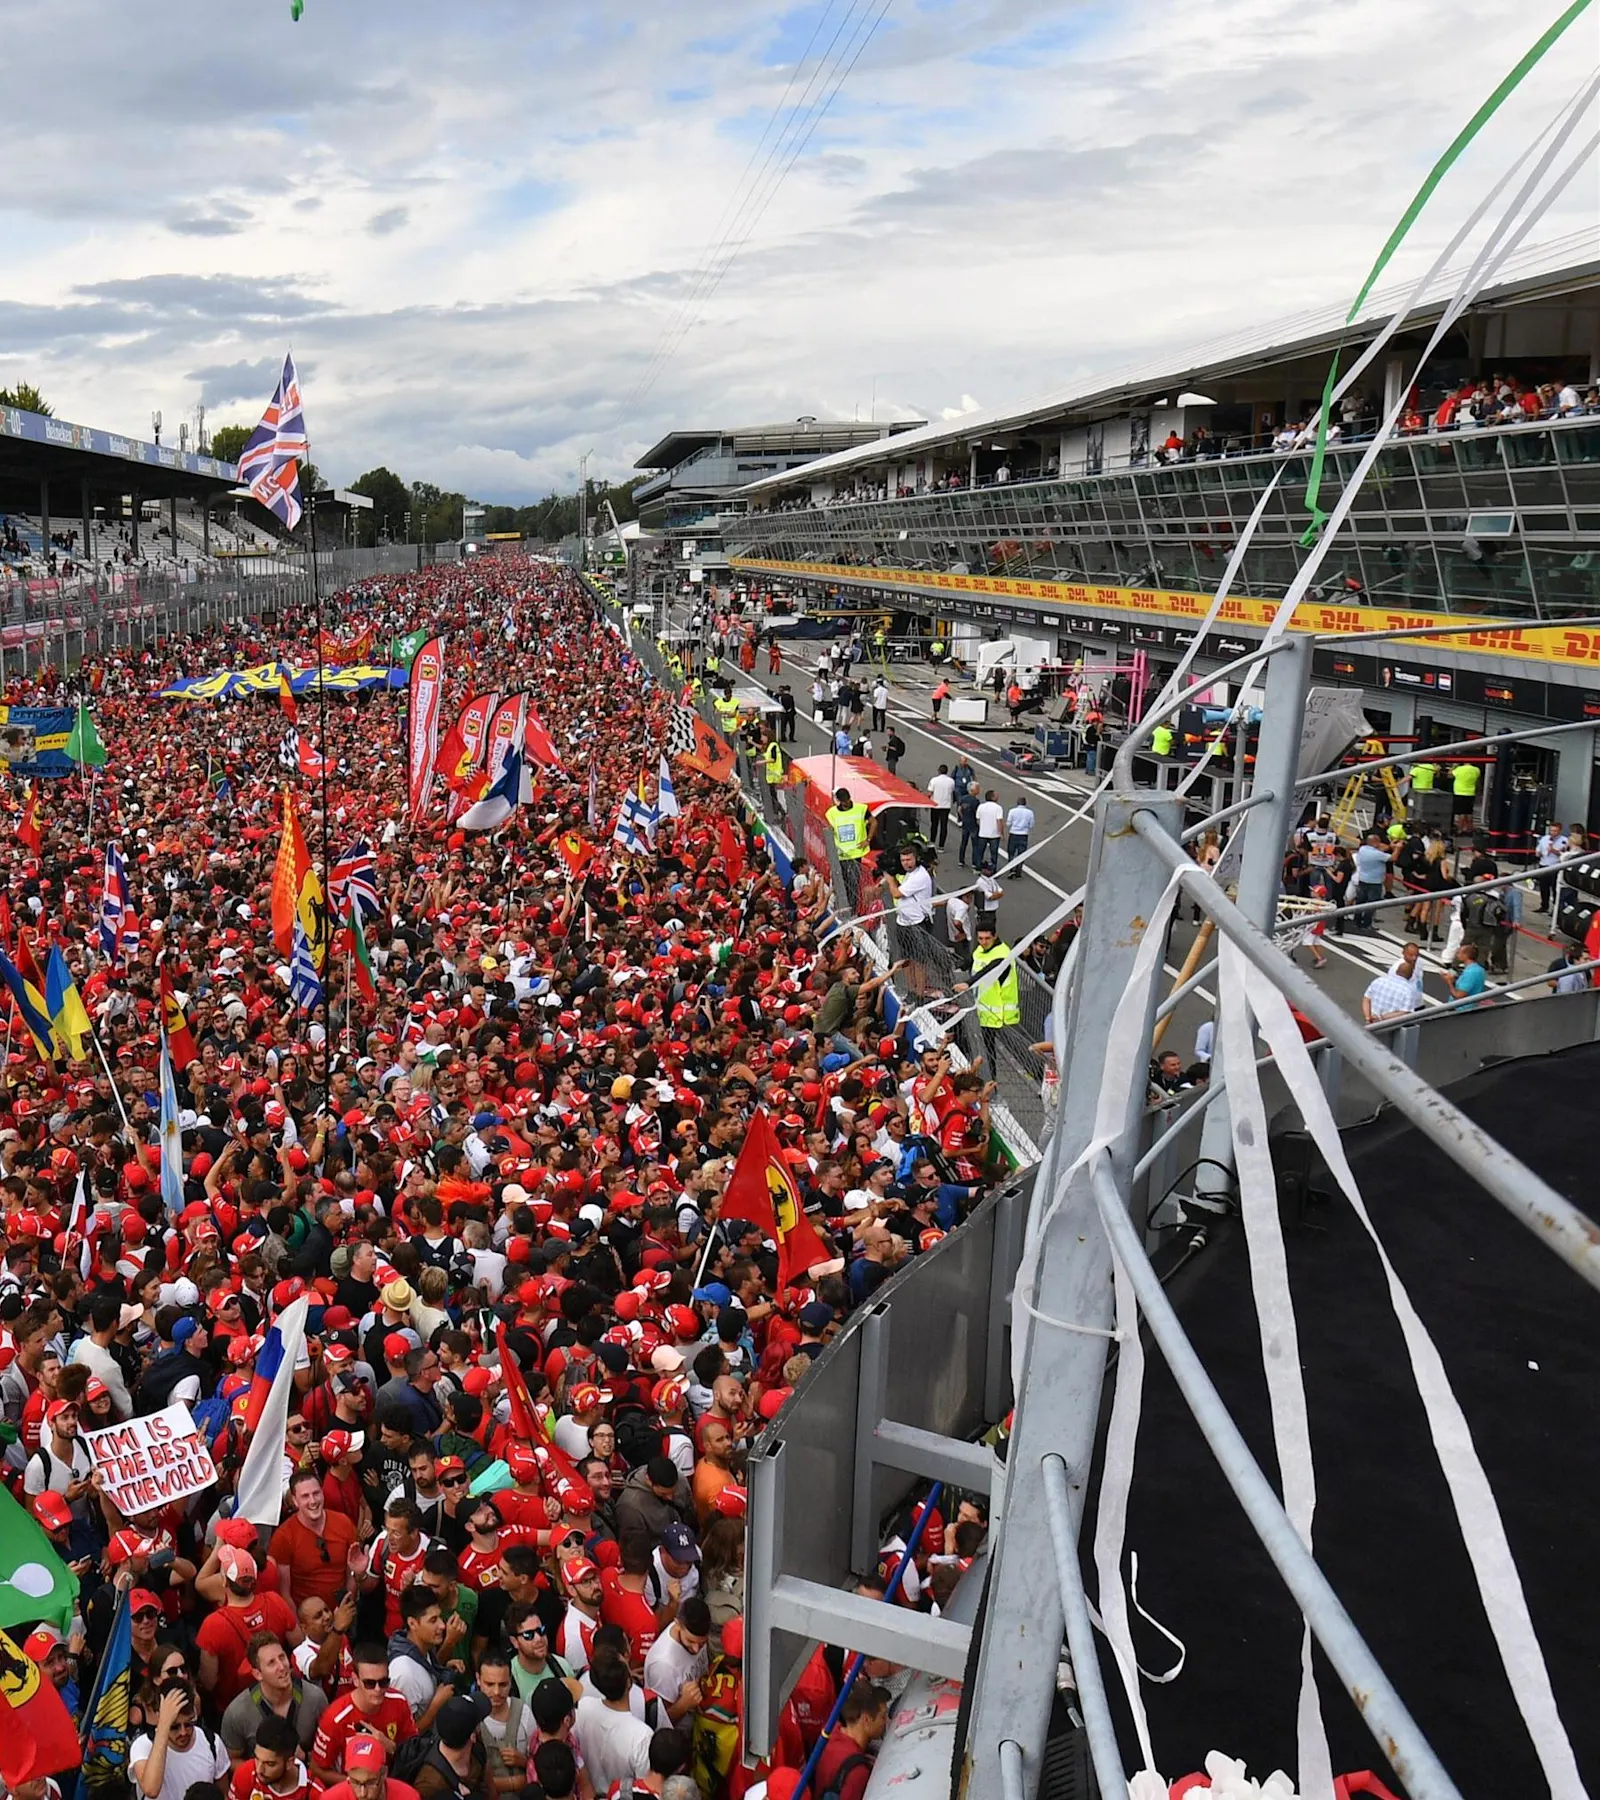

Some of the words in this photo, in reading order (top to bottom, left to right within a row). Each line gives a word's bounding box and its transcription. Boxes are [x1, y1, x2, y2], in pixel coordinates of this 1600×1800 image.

[993, 581, 1009, 592] DHL
[1016, 583, 1033, 595] DHL
[1040, 585, 1059, 598] DHL
[1067, 588, 1088, 601] DHL
[1097, 590, 1120, 604] DHL
[1131, 592, 1158, 609] DHL
[1169, 596, 1200, 613] DHL
[1216, 601, 1247, 619] DHL
[1262, 604, 1302, 625] DL
[1320, 610, 1364, 631] DHL
[1387, 615, 1440, 641] DHL
[89, 1427, 141, 1461] KIMI
[144, 1417, 172, 1442] IS
[97, 1451, 147, 1484] THE
[148, 1432, 201, 1469] BEST
